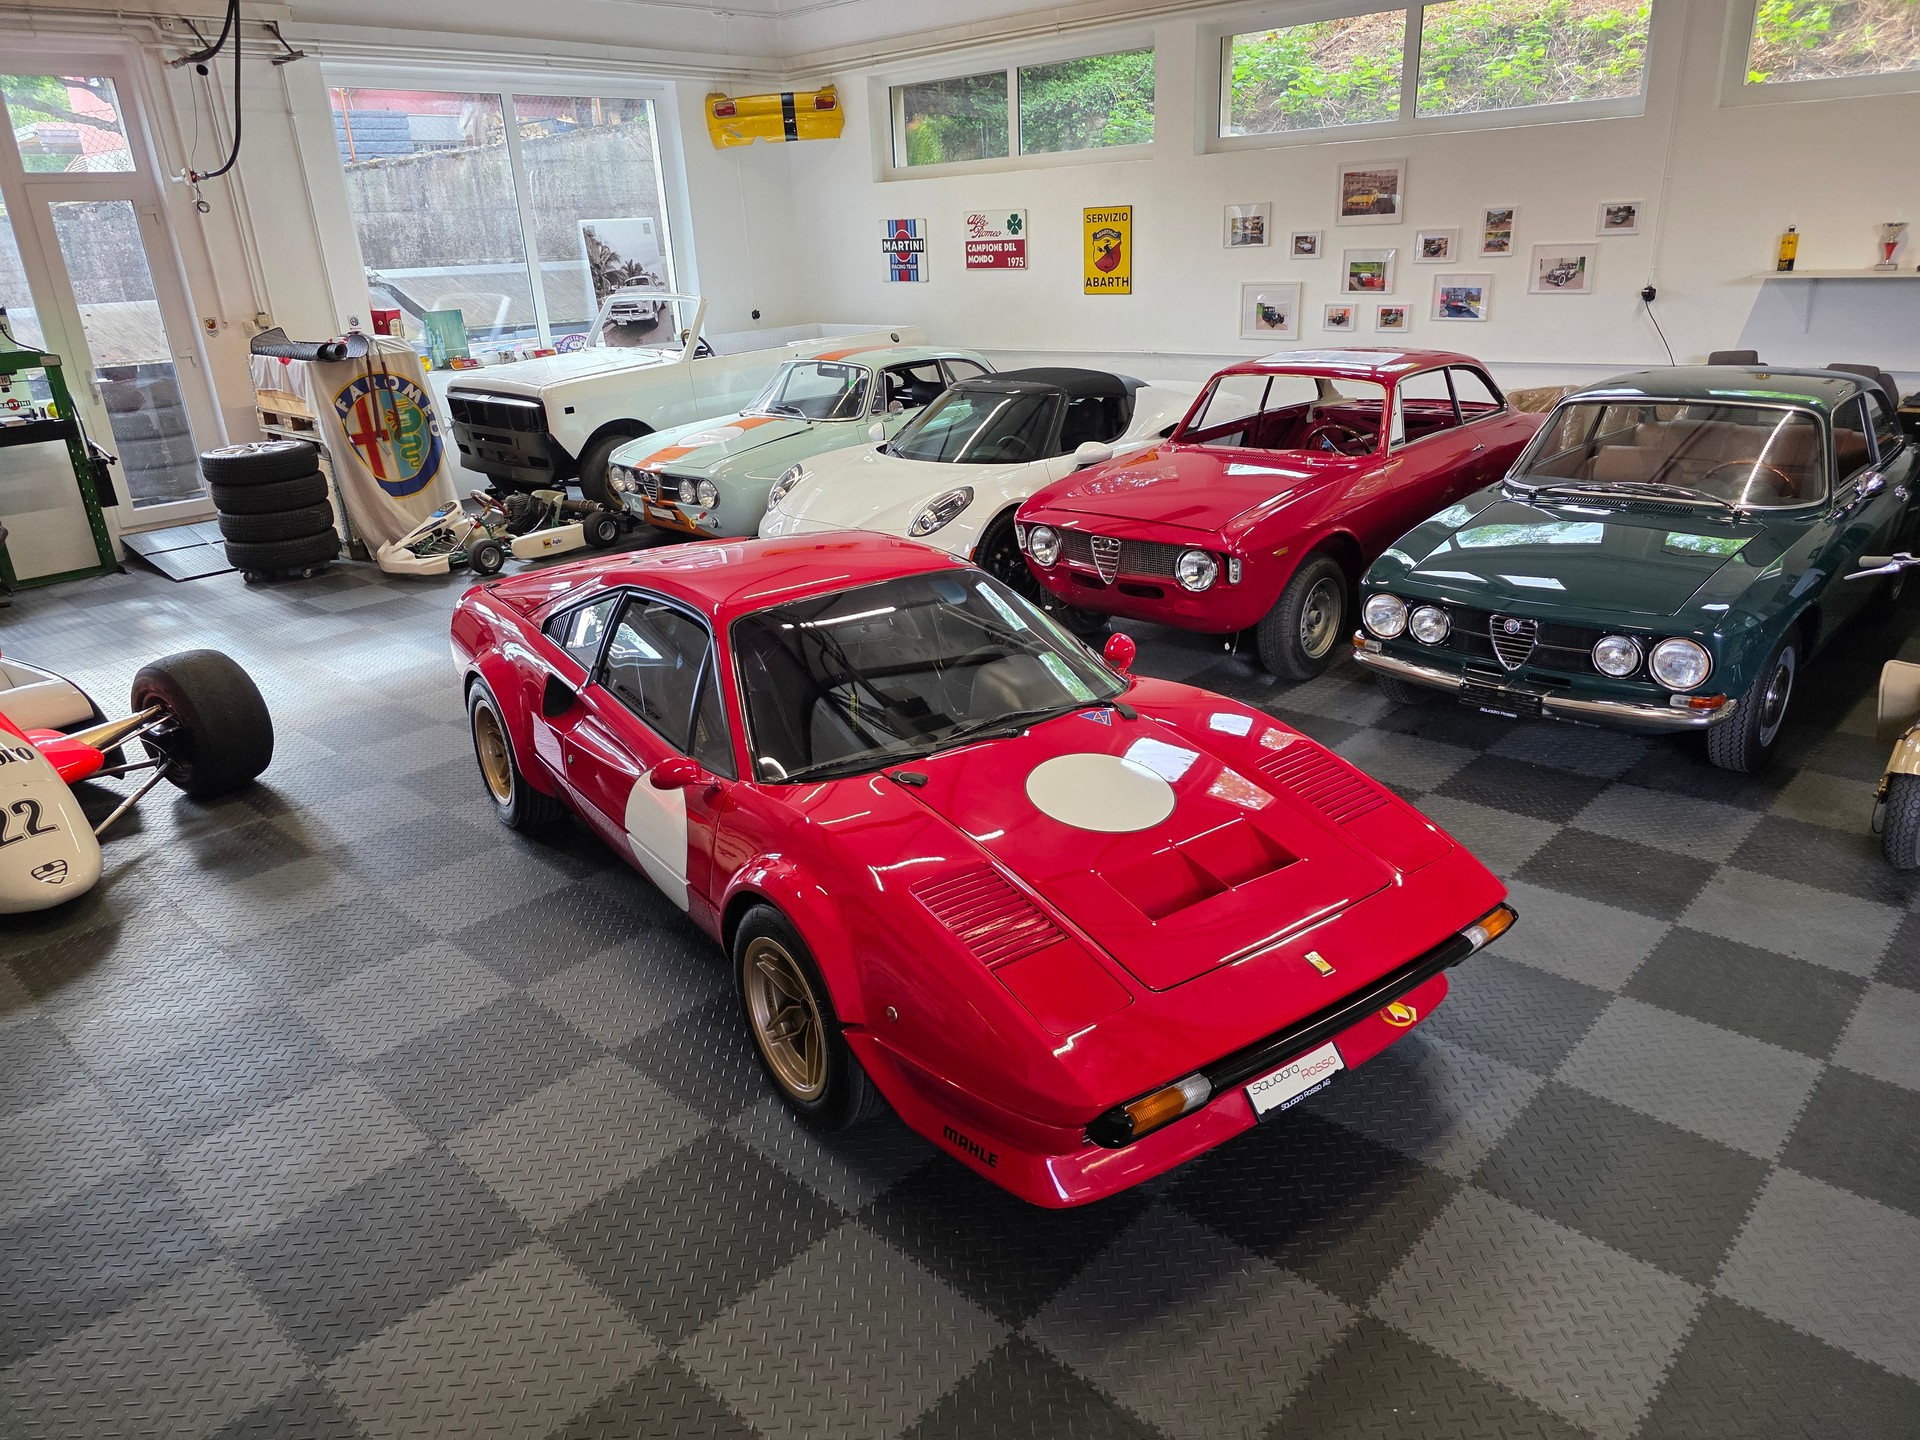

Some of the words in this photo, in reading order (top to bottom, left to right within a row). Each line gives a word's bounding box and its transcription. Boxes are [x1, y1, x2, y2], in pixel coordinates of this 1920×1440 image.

[967, 214, 989, 226] Alfa
[1086, 212, 1128, 223] SERVIZIO
[969, 225, 1002, 239] Romeo
[883, 240, 923, 251] MARTINI
[967, 243, 1003, 252] CAMPIONE
[1004, 243, 1017, 251] DEL
[968, 255, 994, 264] MONDO
[1007, 257, 1024, 267] 1975
[1085, 276, 1129, 287] ABARTH
[1252, 1064, 1300, 1095] Squadra
[1322, 1078, 1331, 1088] AG
[943, 1124, 998, 1168] MAHLE
